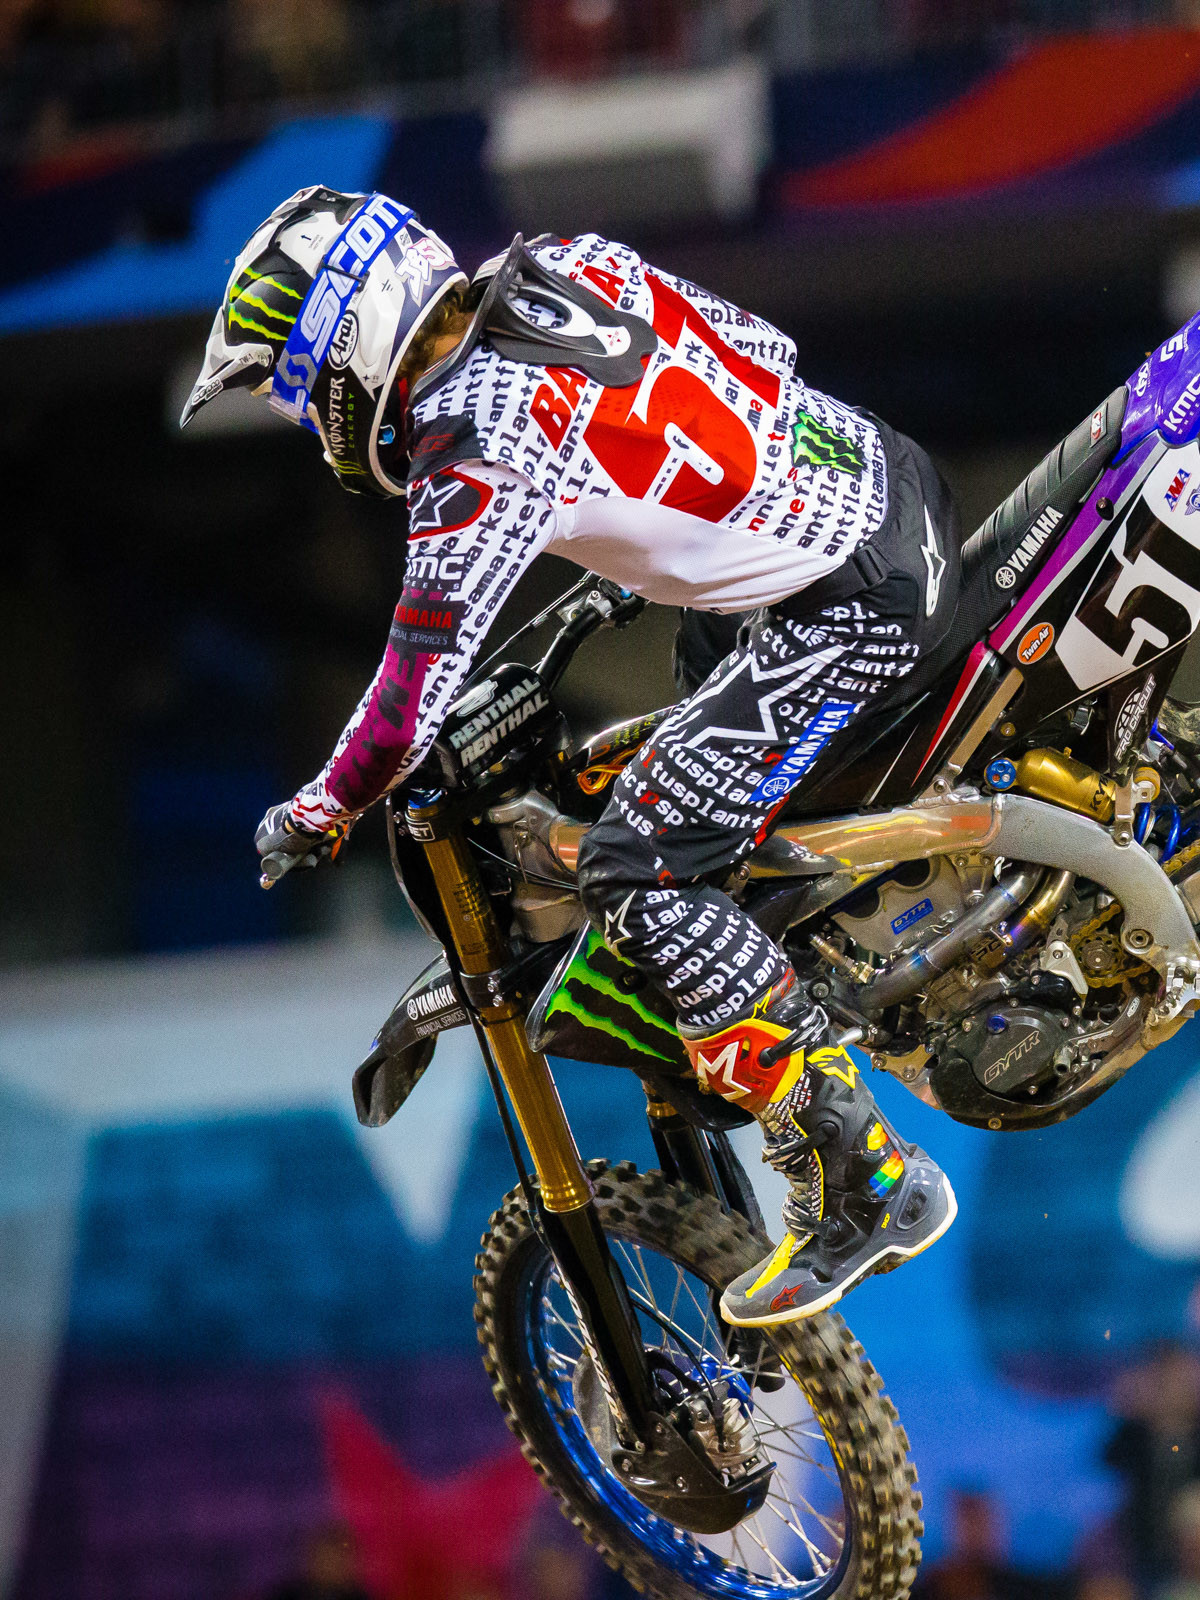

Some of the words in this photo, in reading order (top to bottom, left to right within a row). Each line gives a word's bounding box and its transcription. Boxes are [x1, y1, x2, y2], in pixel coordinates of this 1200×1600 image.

[333, 316, 354, 365] Arai
[328, 377, 345, 456] MONSTER
[347, 392, 355, 449] ENERGY
[1164, 468, 1191, 512] AMA
[1007, 506, 1063, 573] YAMAHA
[1022, 639, 1040, 660] Twin
[1039, 627, 1049, 642] Air
[449, 678, 541, 750] RENTHAL
[460, 692, 548, 768] RENTHAL
[1115, 730, 1132, 762] PRO
[1129, 677, 1156, 731] CIRCUIT
[894, 902, 926, 927] GYTR
[415, 984, 457, 1016] YAMAHA
[440, 1010, 466, 1027] SERVICES
[984, 1030, 1040, 1085] GYTR
